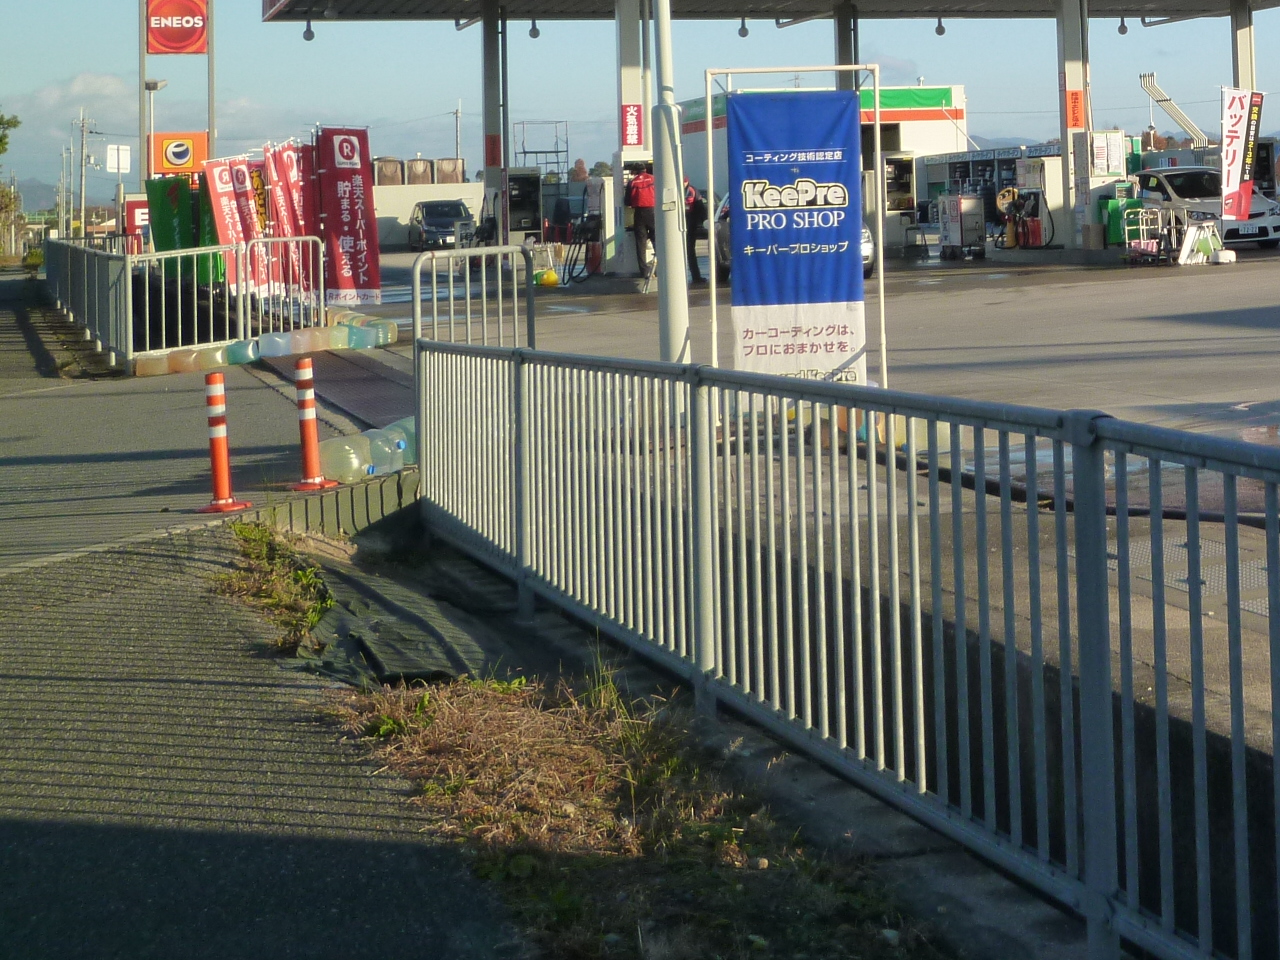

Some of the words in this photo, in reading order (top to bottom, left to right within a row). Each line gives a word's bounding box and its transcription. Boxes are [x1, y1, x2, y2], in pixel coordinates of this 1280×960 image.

[150, 15, 204, 28] ENEOS
[626, 105, 638, 145] 火気厳禁
[1225, 94, 1247, 188] バッテリー
[745, 151, 843, 162] コーティング技術認定店
[743, 179, 848, 209] KeePre
[336, 180, 354, 277] 貯まる・使える
[352, 174, 369, 285] 楽天スーパーポイント
[746, 212, 787, 230] PRO
[792, 210, 846, 229] SHOP
[743, 240, 849, 256] キーパープロショップ
[742, 324, 856, 340] カーコーティングは、
[742, 341, 856, 357] プロにおまかせを。
